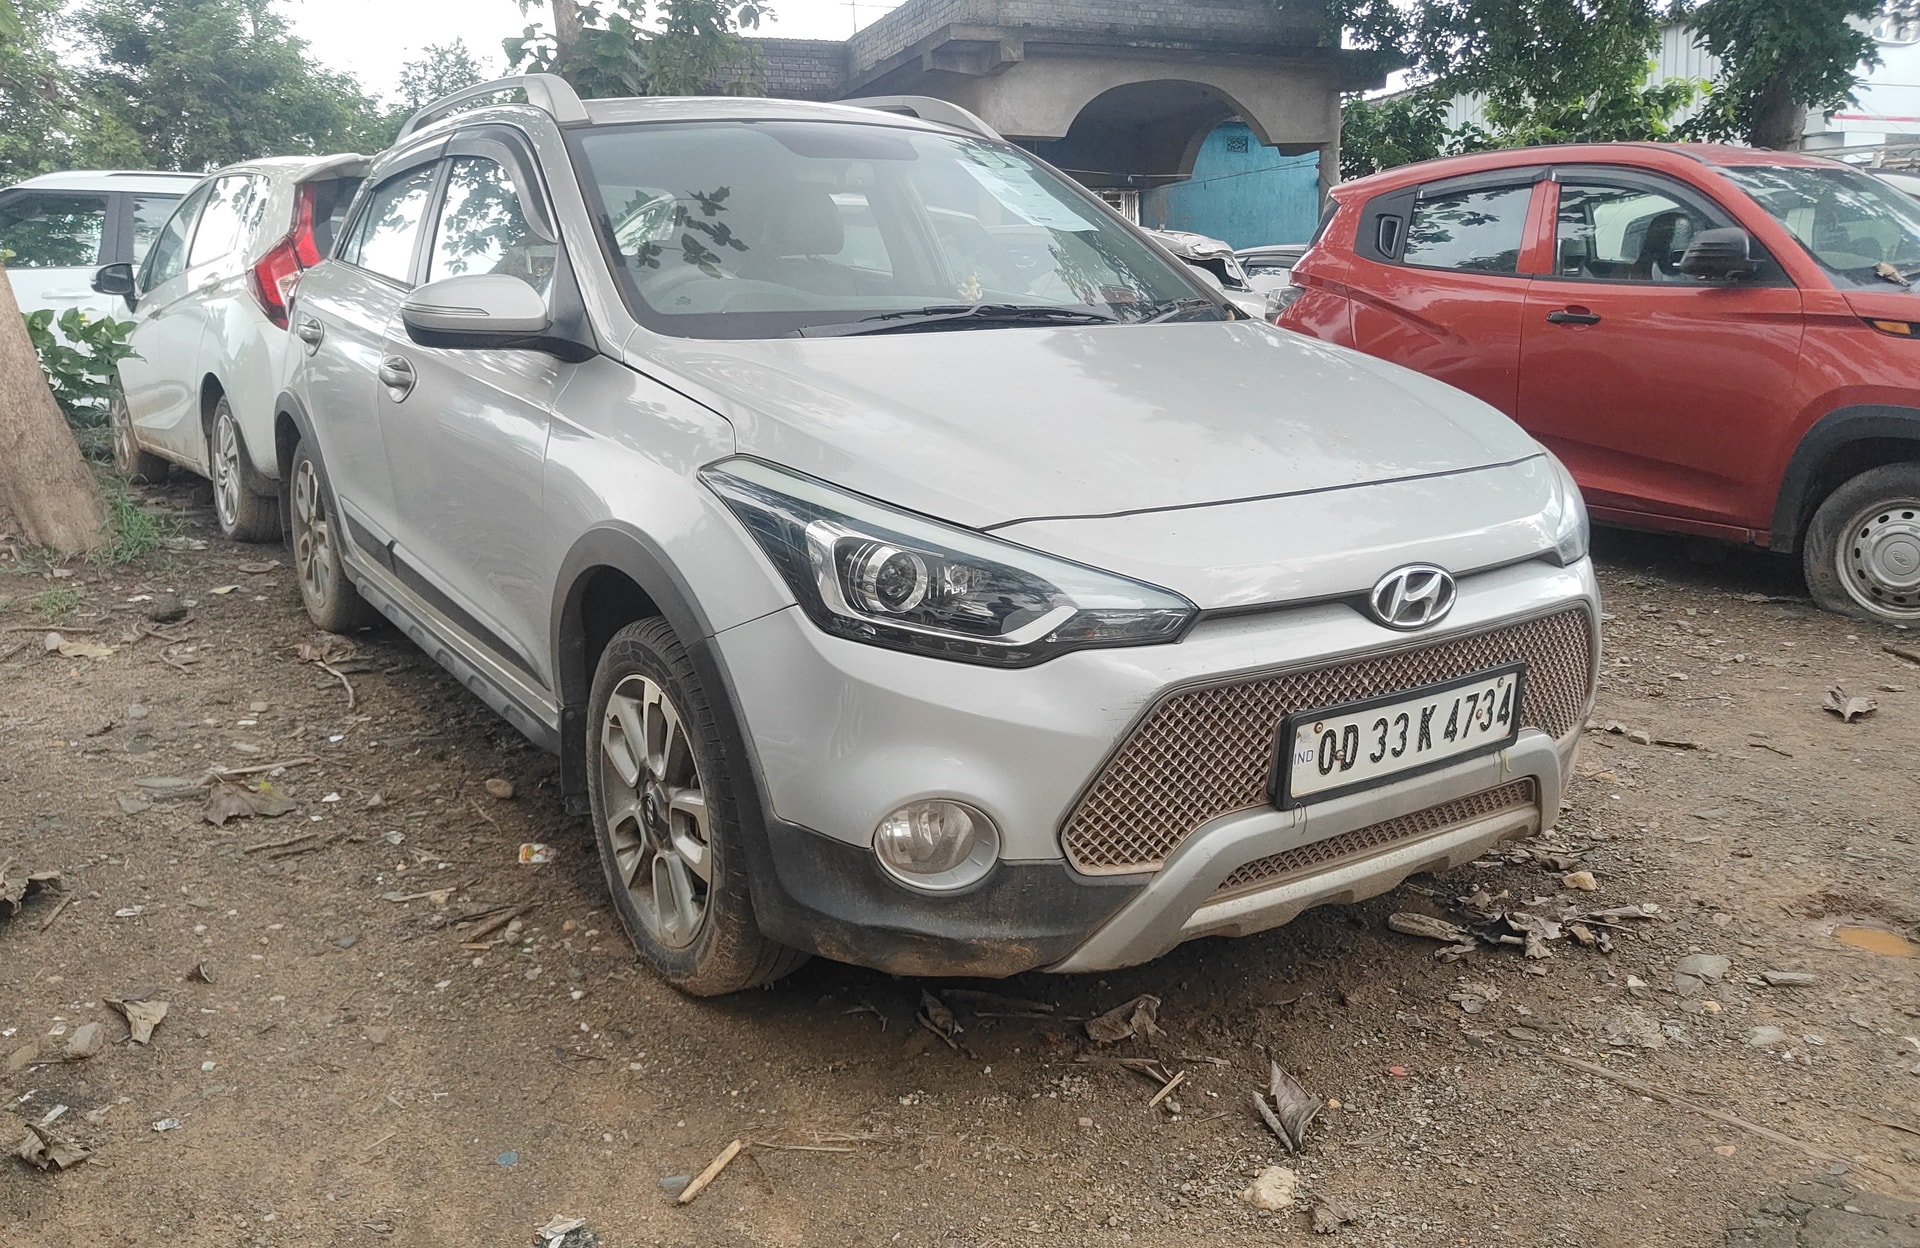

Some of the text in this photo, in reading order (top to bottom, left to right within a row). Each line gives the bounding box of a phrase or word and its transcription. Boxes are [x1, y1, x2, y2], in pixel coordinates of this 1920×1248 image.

[1369, 712, 1410, 763] 33
[1416, 704, 1437, 752] K
[1443, 682, 1512, 743] 4734
[1293, 749, 1314, 766] IND
